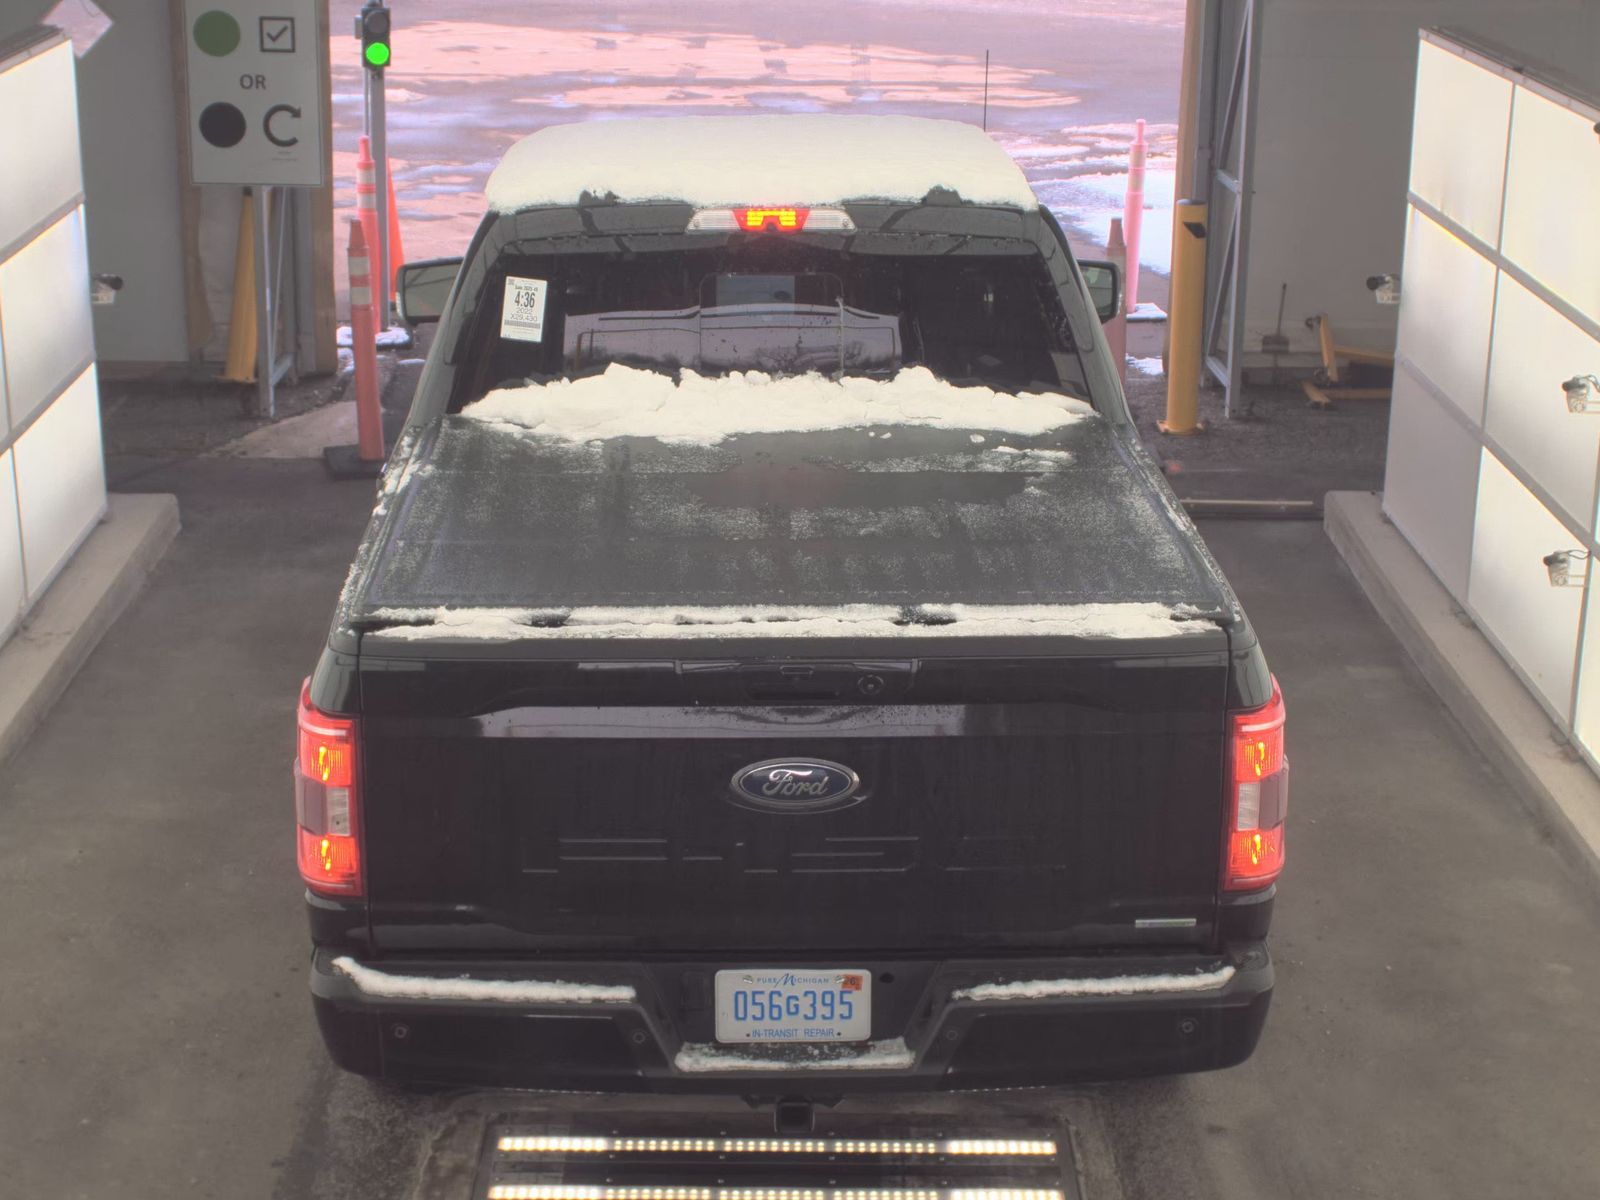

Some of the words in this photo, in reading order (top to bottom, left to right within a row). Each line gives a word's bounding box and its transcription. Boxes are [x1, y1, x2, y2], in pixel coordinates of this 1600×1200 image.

[239, 74, 266, 90] OR
[514, 290, 535, 308] 4:36
[762, 769, 829, 796] Ford
[757, 976, 777, 985] PURE
[775, 973, 829, 987] MICHIGAN
[734, 990, 853, 1021] 056G395
[752, 1028, 798, 1038] IN-TRANSIT
[804, 1027, 834, 1037] REPAIR
